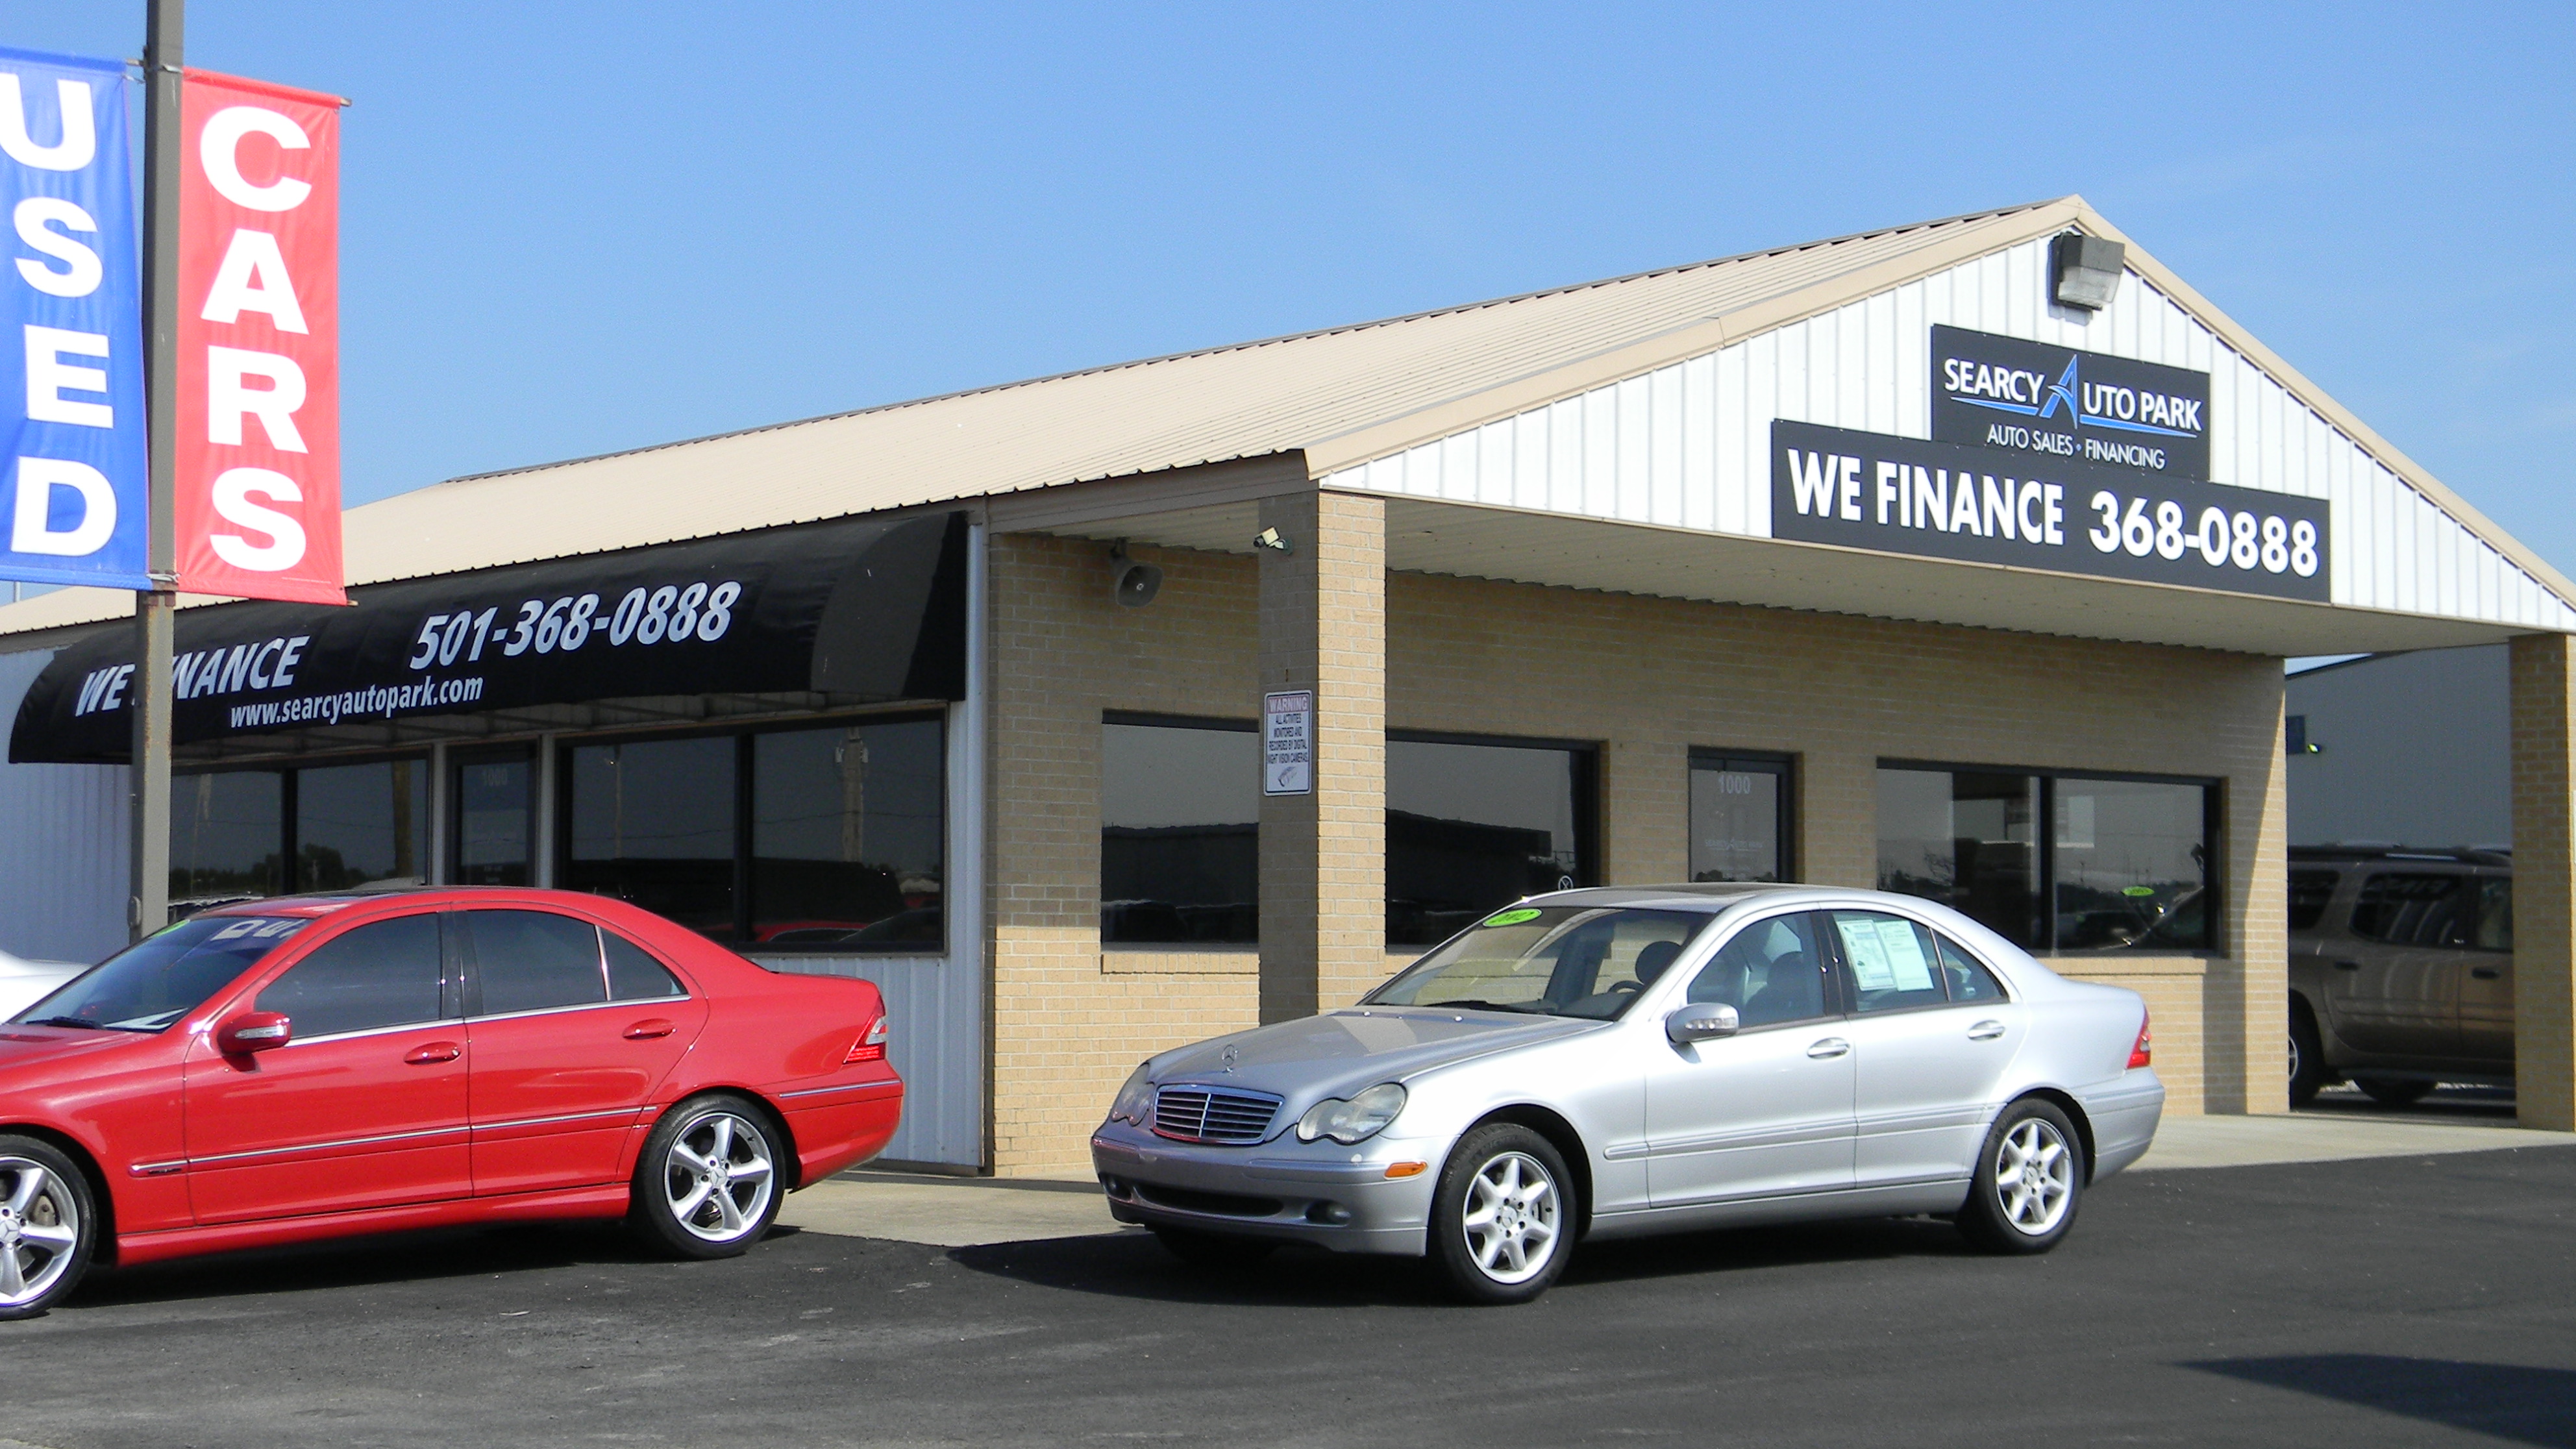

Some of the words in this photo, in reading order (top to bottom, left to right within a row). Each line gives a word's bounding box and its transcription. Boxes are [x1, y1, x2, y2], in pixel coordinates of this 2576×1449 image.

[0, 73, 117, 556] USED
[200, 106, 312, 571] CARS
[1944, 358, 2045, 404] SEARCY
[2140, 391, 2201, 431] PARK
[1987, 423, 2029, 449] AUTO
[2032, 431, 2074, 456] SALES
[2085, 438, 2166, 470] FINANCING
[1788, 448, 1861, 521] WE
[1876, 461, 2064, 545] FINANCE
[2089, 491, 2318, 577] 368-0888
[75, 663, 136, 717] WE
[132, 636, 310, 706] NANCE
[410, 581, 741, 669] 501-368-0888
[230, 675, 484, 728] www.searcyautopark.com
[1269, 697, 1308, 713] WARNING
[1718, 774, 1752, 795] 1000
